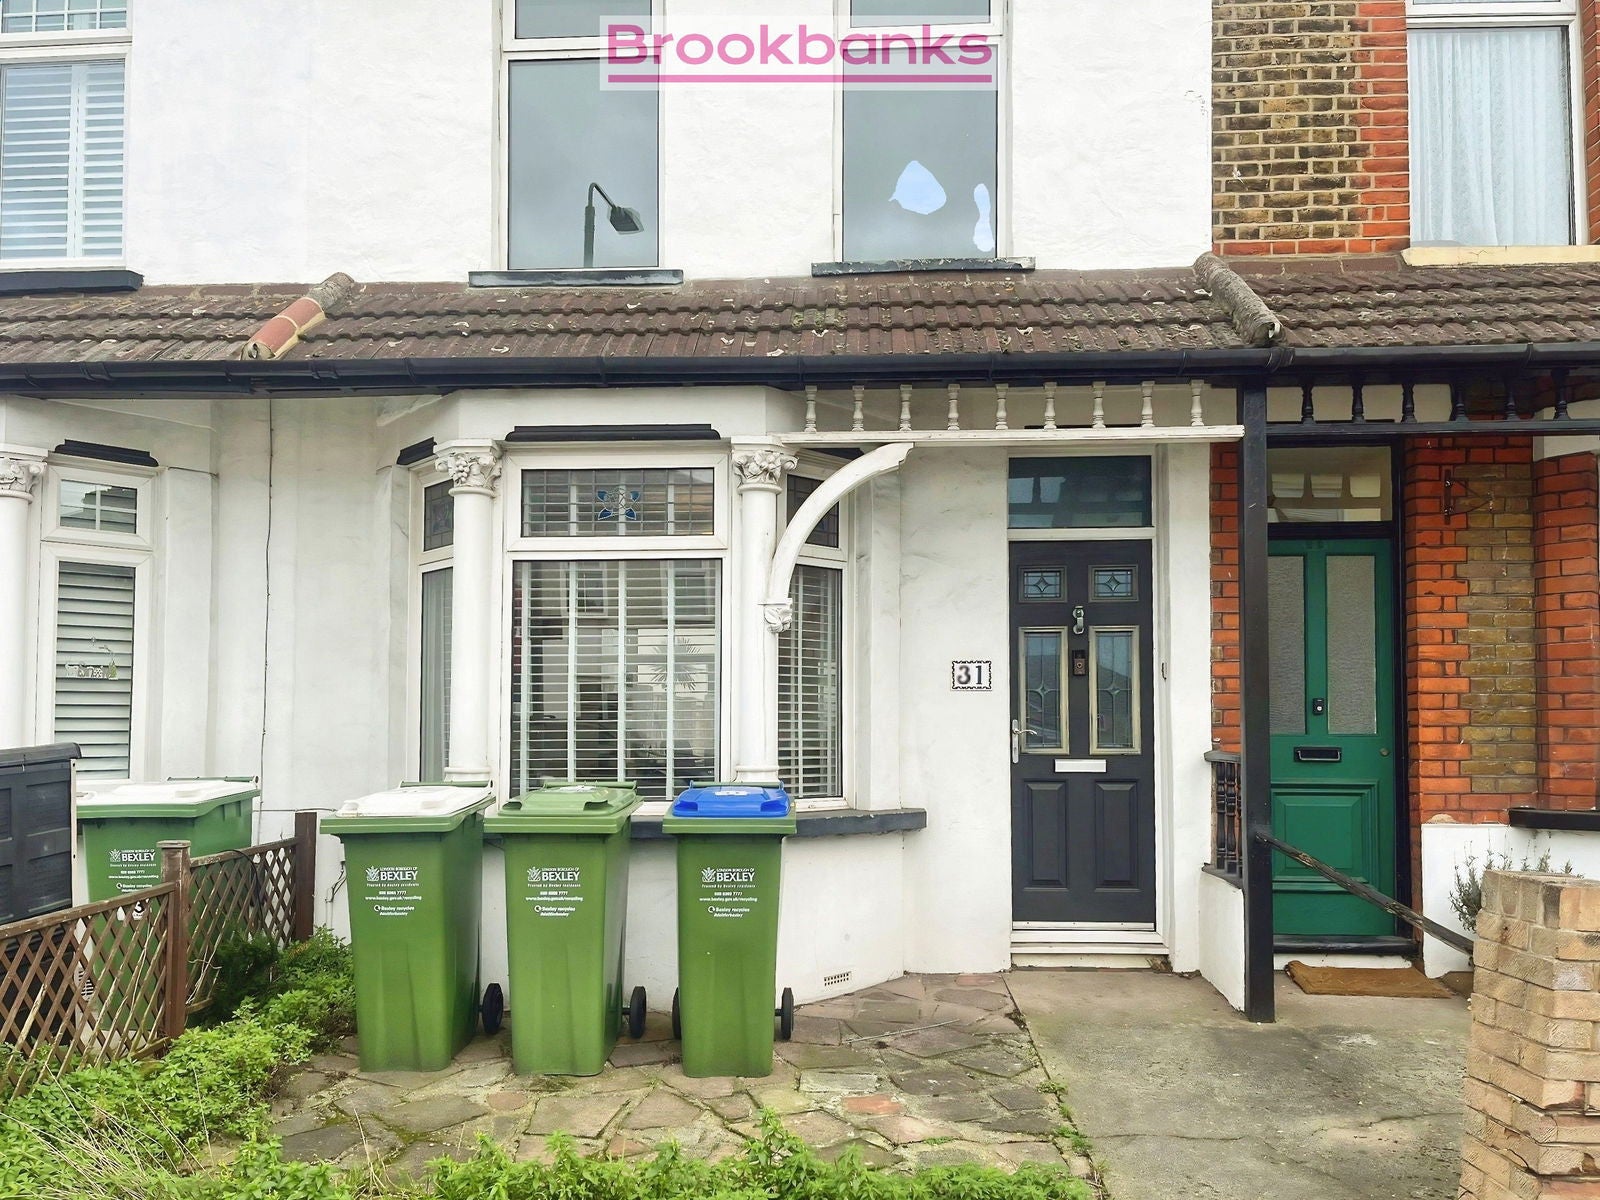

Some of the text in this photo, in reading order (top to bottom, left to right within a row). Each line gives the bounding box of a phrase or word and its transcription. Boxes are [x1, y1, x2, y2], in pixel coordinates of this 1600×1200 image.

[956, 665, 982, 685] 31
[121, 852, 156, 862] BEXLEY
[380, 870, 418, 881] BEXLEY
[541, 871, 580, 881] BEXLEY
[716, 872, 755, 882] BEXLEY
